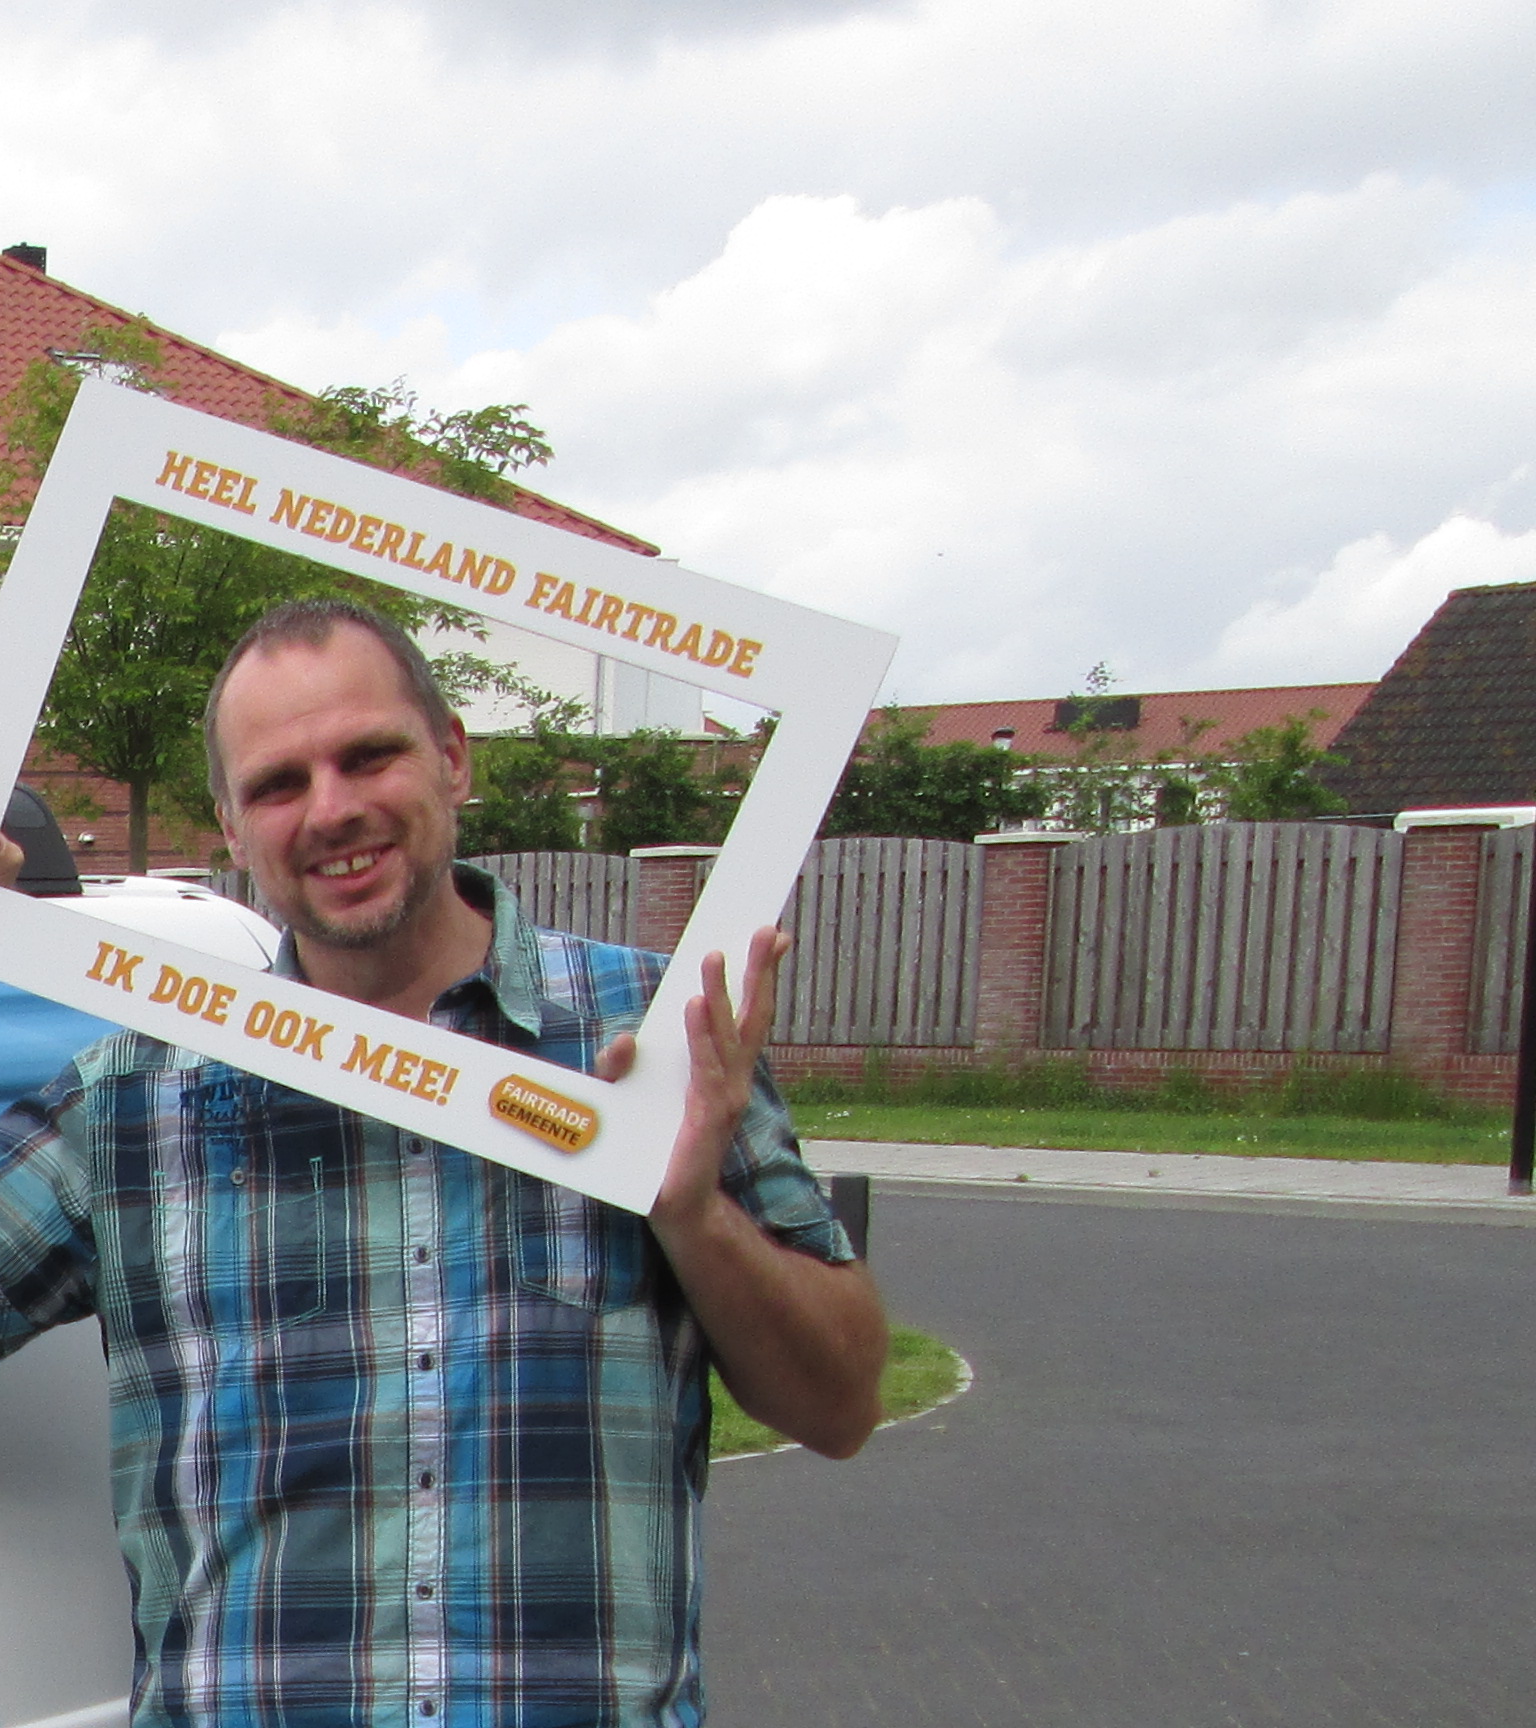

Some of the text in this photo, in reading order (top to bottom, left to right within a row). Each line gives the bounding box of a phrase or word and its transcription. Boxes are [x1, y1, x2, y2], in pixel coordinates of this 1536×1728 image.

[155, 450, 764, 679] HEEL NEDERLAND FAIRTRADE
[85, 941, 461, 1106] IK DOE OOK MEE!
[495, 1099, 582, 1146] GEMEENTE
[501, 1081, 591, 1131] FAIRTRADE
